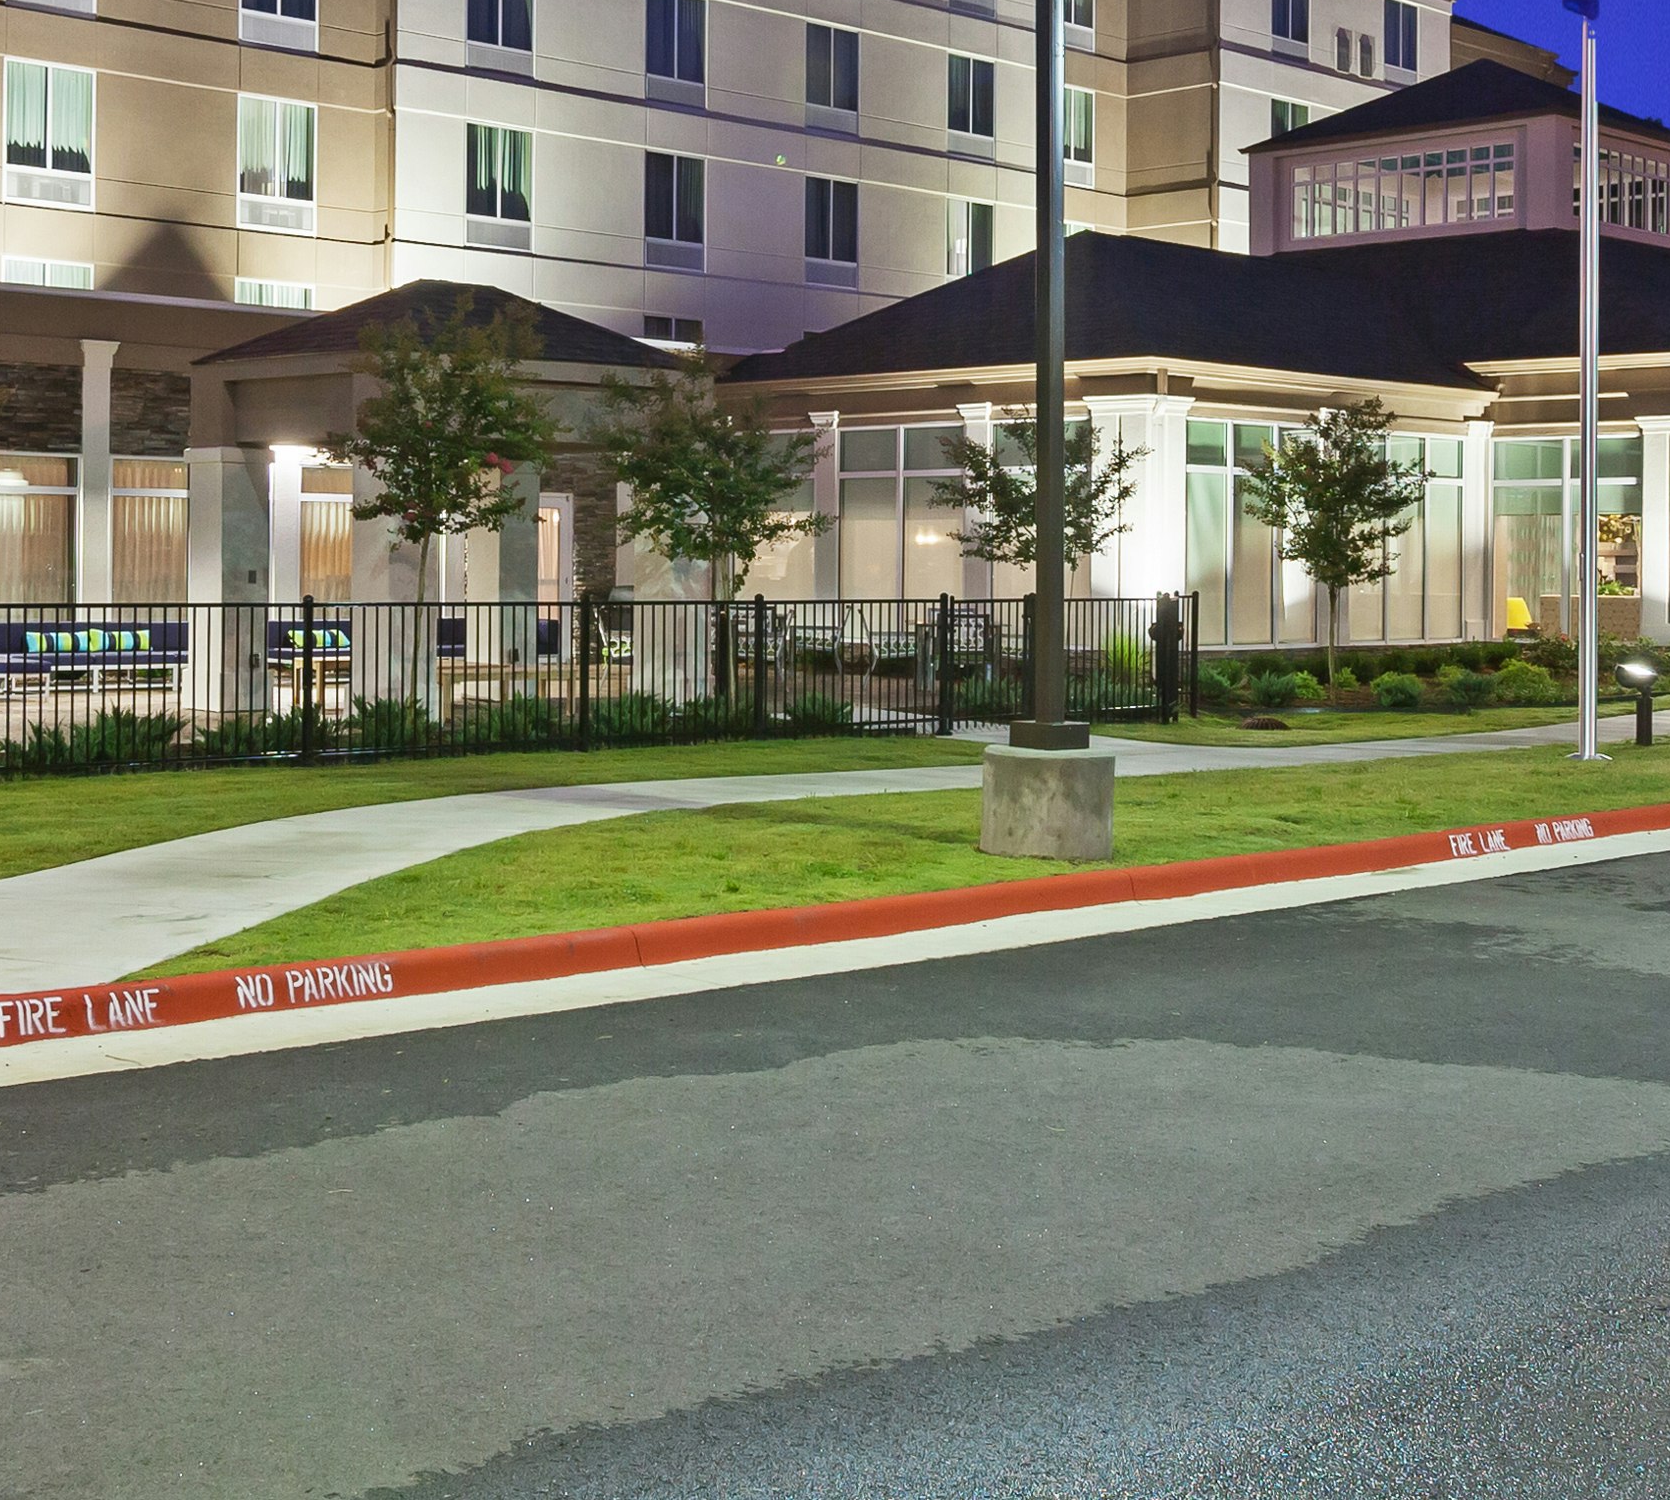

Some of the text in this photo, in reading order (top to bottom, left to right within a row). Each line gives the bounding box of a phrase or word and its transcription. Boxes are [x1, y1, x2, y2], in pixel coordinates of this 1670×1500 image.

[1448, 818, 1594, 857] FIRE LANE NO PARKING
[86, 988, 160, 1033] LANE
[235, 974, 274, 1009] NO
[285, 962, 394, 1003] PARKING
